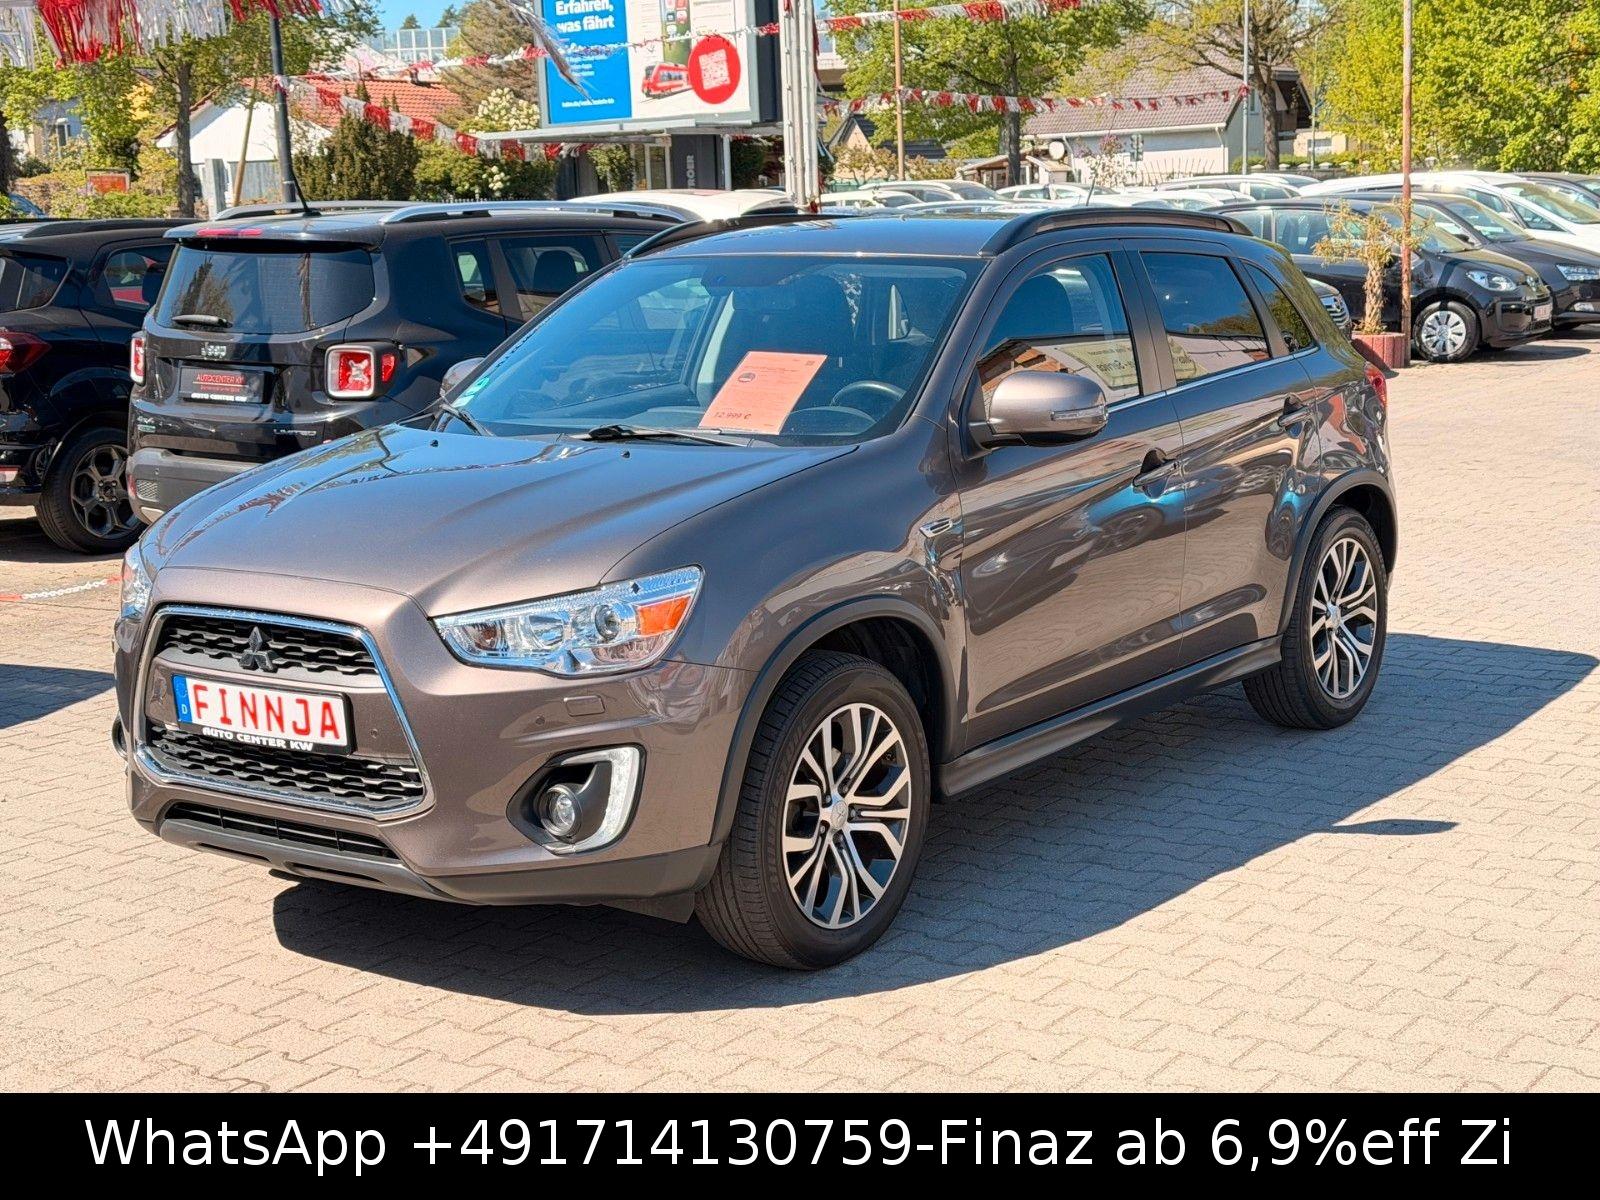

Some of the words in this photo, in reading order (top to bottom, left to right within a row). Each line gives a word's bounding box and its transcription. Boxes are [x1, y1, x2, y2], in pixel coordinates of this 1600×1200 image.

[555, 0, 614, 16] Erfahren,
[556, 21, 581, 33] was
[582, 14, 615, 31] fährt
[181, 704, 188, 715] D
[192, 683, 341, 740] FINNJA
[202, 727, 234, 741] AUTO
[236, 732, 287, 749] CENTER
[289, 740, 314, 752] KW
